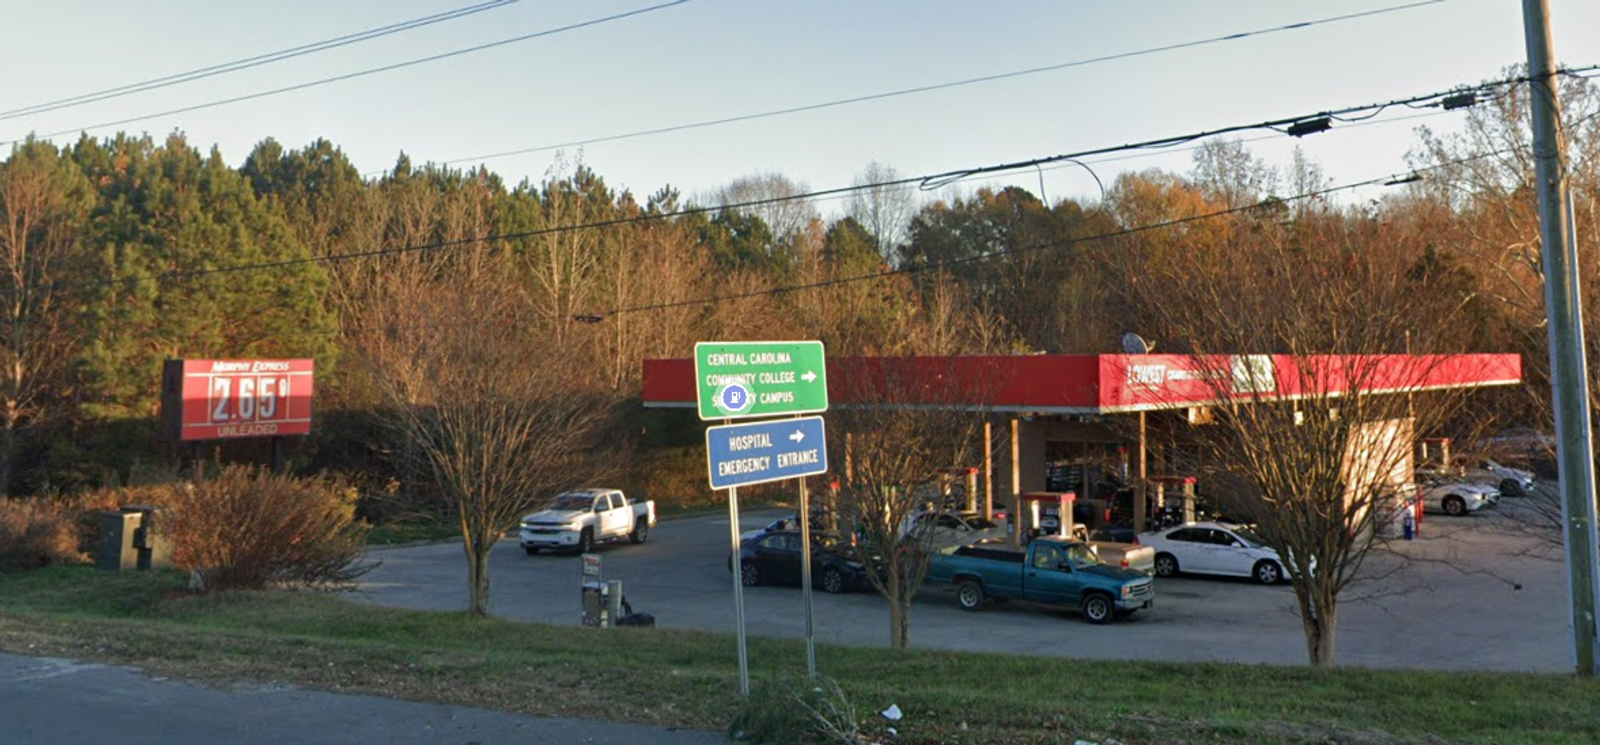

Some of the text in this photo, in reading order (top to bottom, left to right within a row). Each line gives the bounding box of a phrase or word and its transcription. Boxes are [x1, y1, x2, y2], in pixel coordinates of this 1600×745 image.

[707, 352, 791, 366] CENTRAL CAROLINA
[252, 361, 289, 372] EXPRESS
[706, 371, 795, 387] COMMUNITY COLLEGE
[760, 391, 794, 404] CAMPUS
[217, 424, 278, 437] UNLEADED
[729, 433, 773, 452] HOSPITAL
[718, 449, 819, 477] EMERGENCY ENTRANCE
